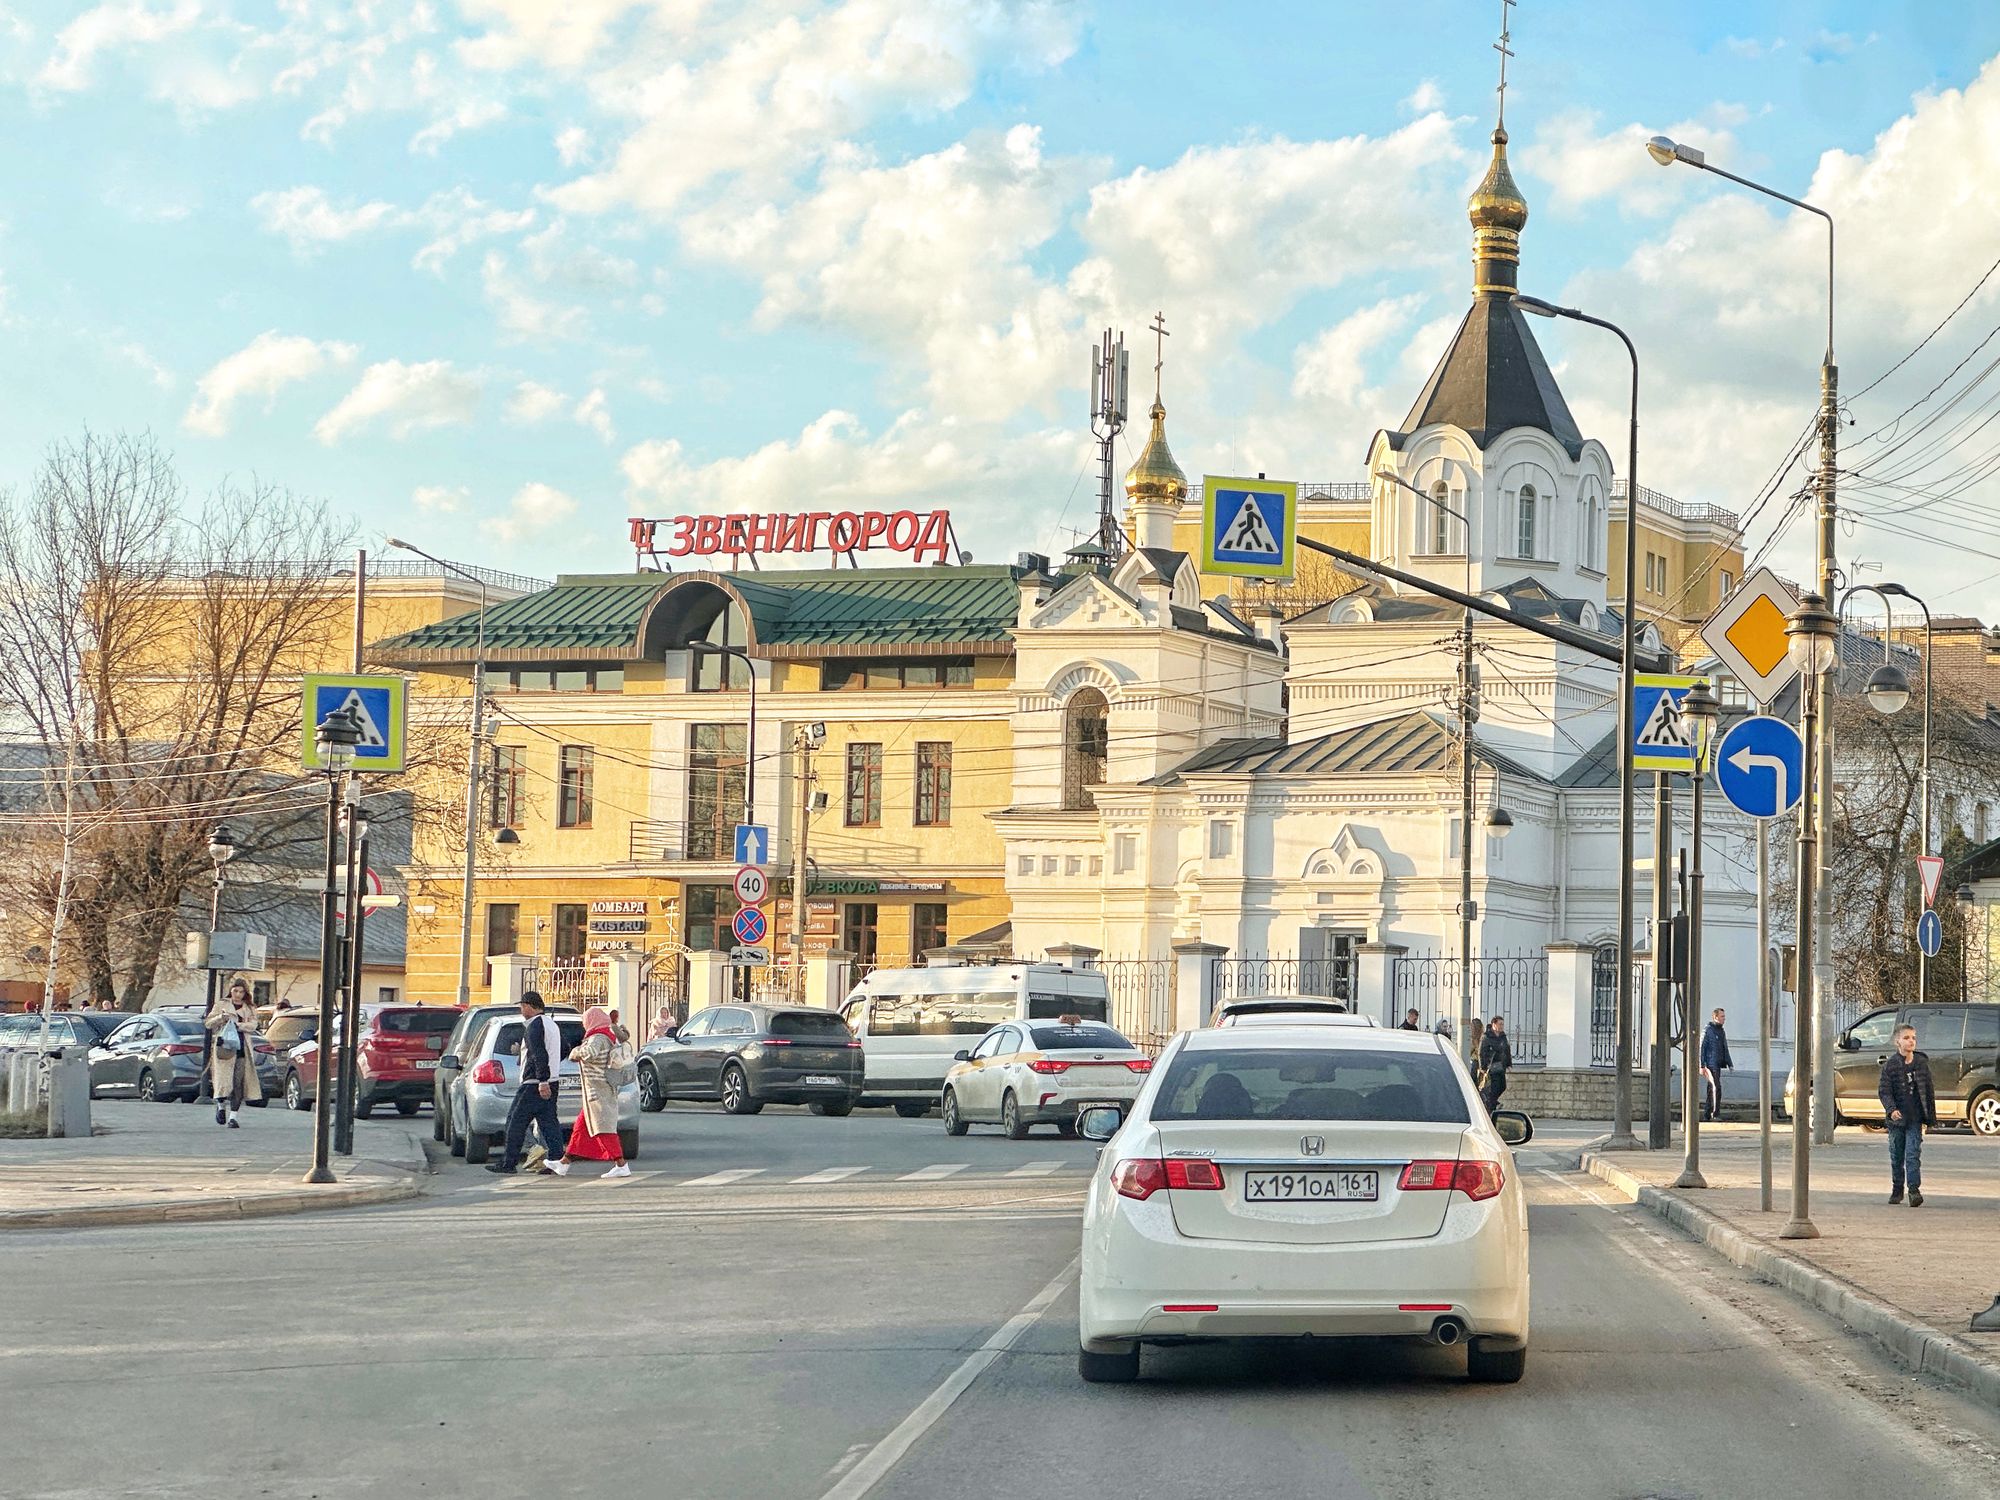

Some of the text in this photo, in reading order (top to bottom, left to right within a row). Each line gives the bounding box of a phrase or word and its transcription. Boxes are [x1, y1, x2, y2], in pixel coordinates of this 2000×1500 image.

[628, 510, 949, 563] ТЦ ЗВЕНИГОРОД
[741, 878, 760, 893] 40
[826, 881, 878, 893] ВКУСА
[591, 901, 645, 914] ЛОМБАРД
[590, 921, 641, 931] EXIST.RU
[588, 940, 628, 951] КАДРОВОЕ
[1167, 1148, 1216, 1157] Accord
[1340, 1174, 1371, 1190] 161
